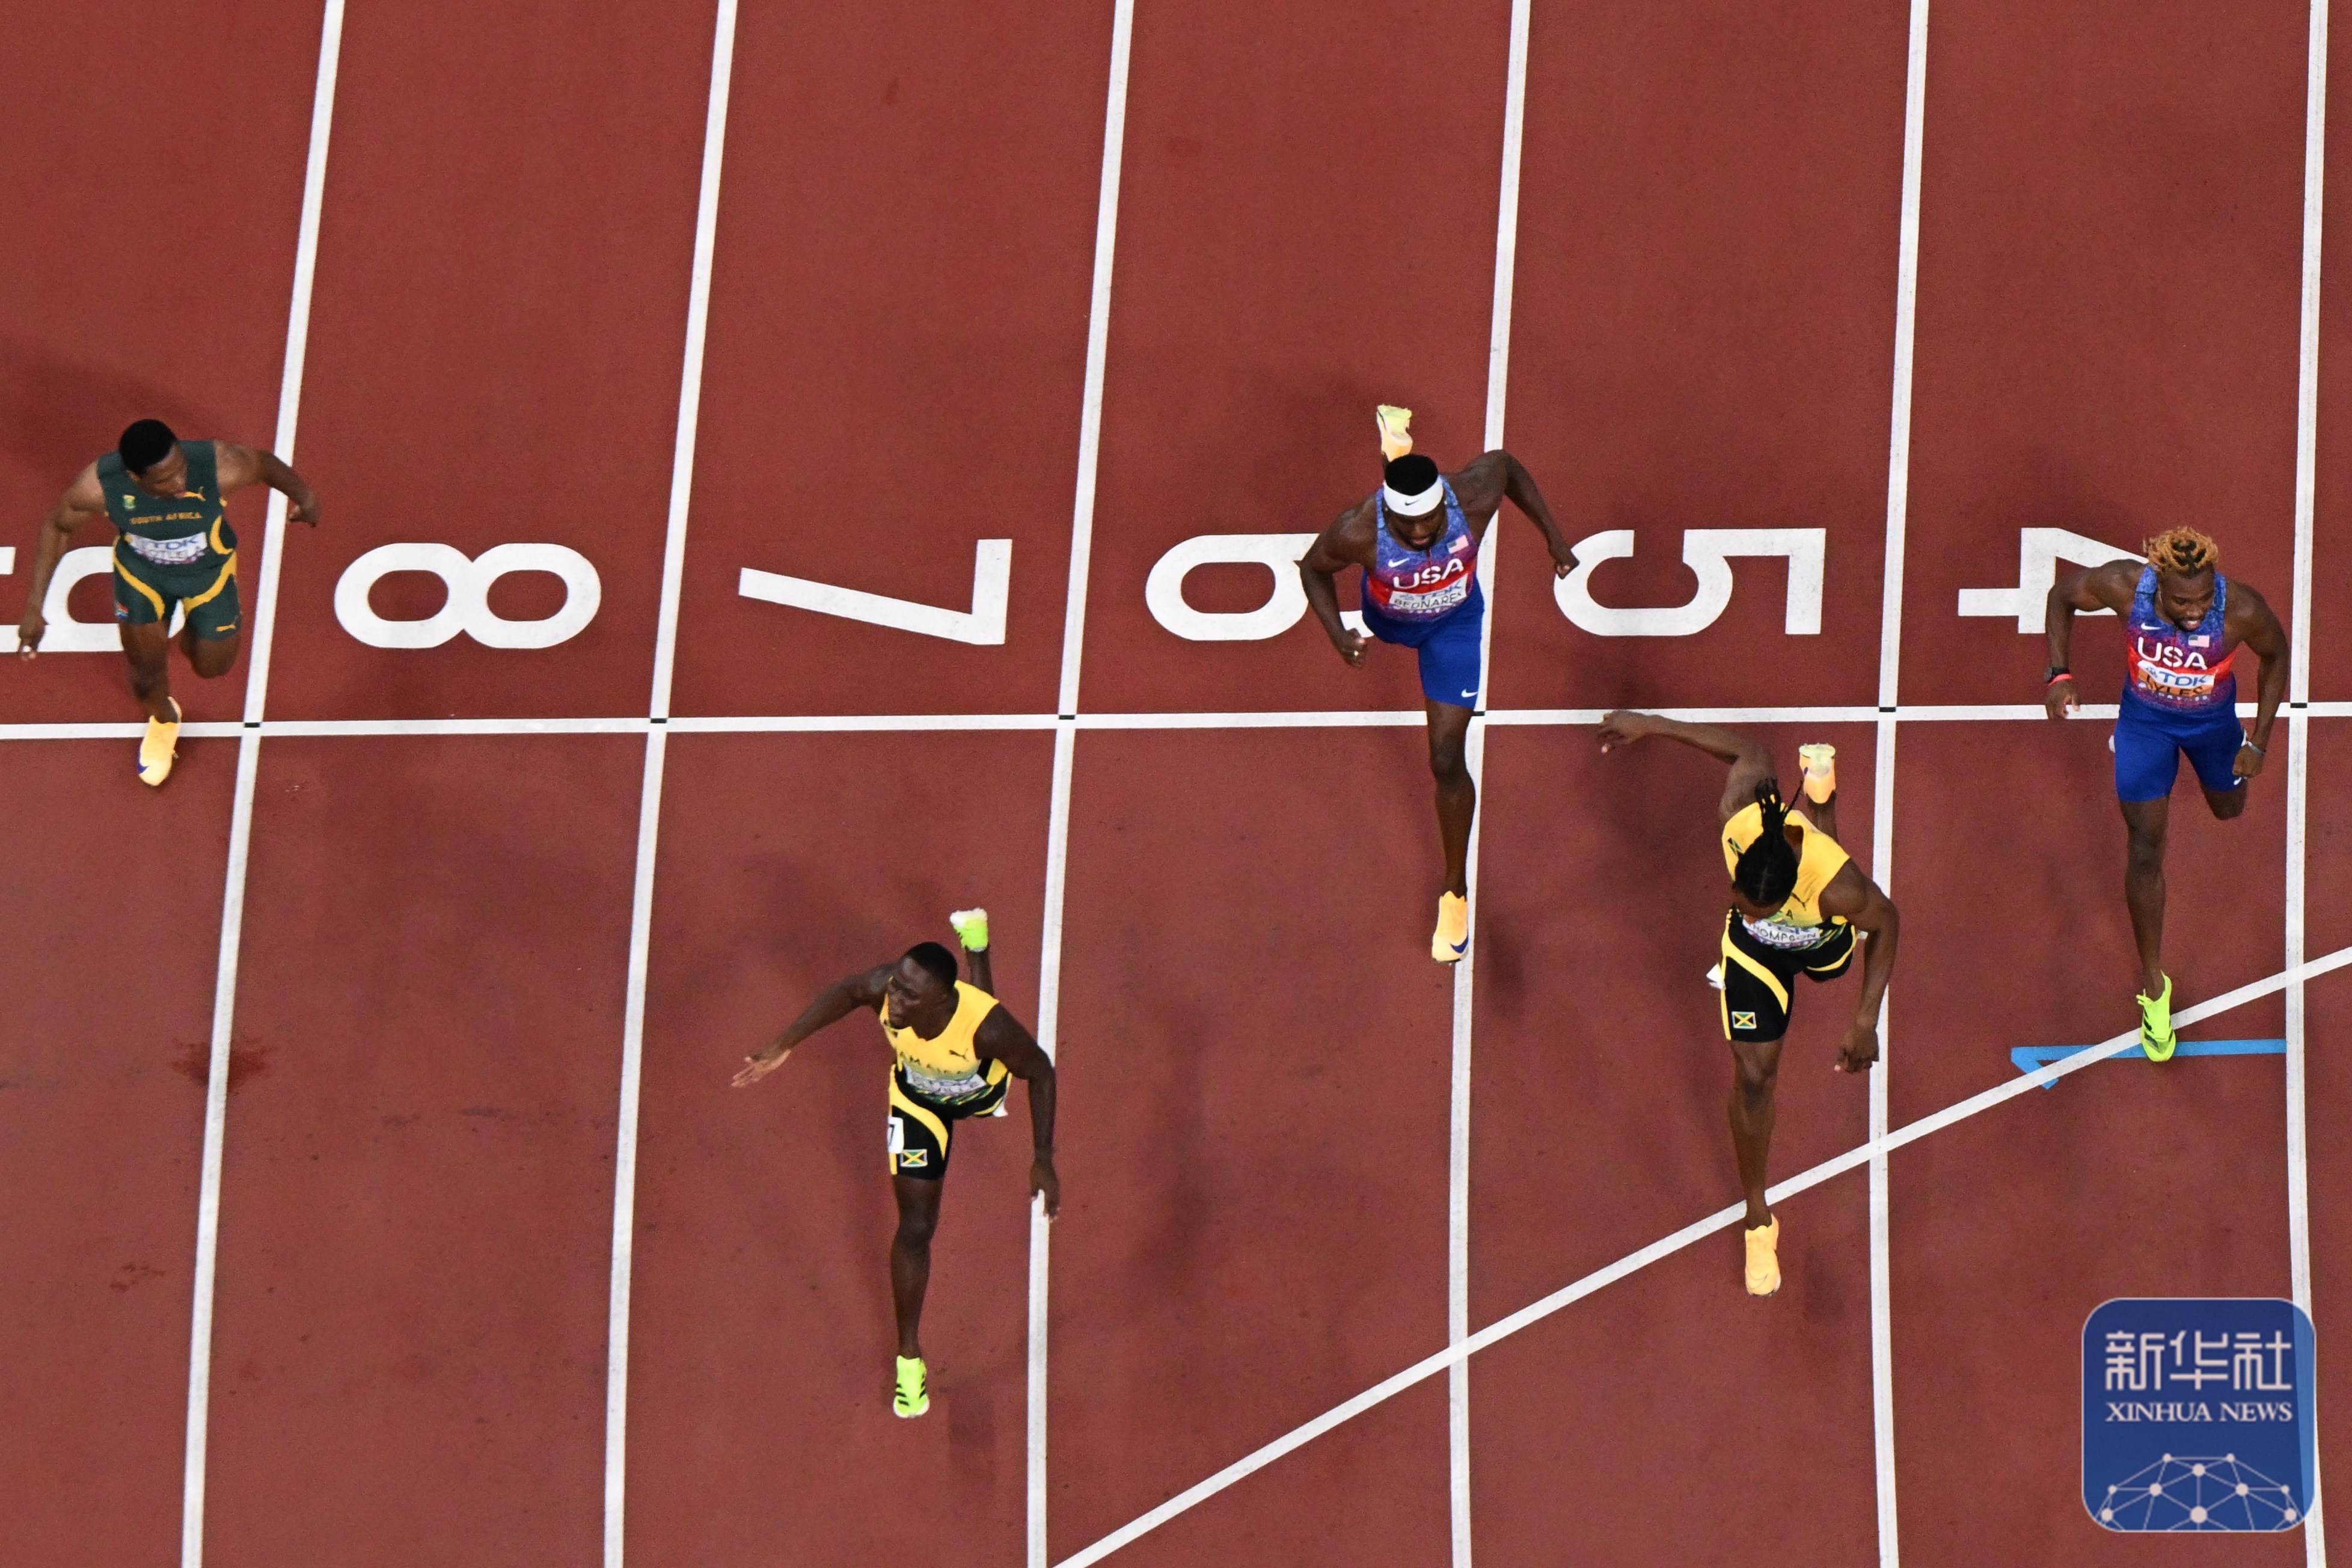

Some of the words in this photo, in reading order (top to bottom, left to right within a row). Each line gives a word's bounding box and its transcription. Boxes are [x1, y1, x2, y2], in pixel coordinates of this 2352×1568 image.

[130, 515, 163, 525] SOUTH
[166, 512, 202, 521] AFRICA
[1393, 558, 1465, 589] USA
[1554, 528, 1826, 637] 5
[1957, 527, 2150, 634] 4
[334, 542, 601, 649] 8
[738, 539, 1013, 645] 7
[2137, 636, 2208, 670] USA
[2158, 670, 2206, 687] TDK
[1753, 923, 1816, 942] OMPSON
